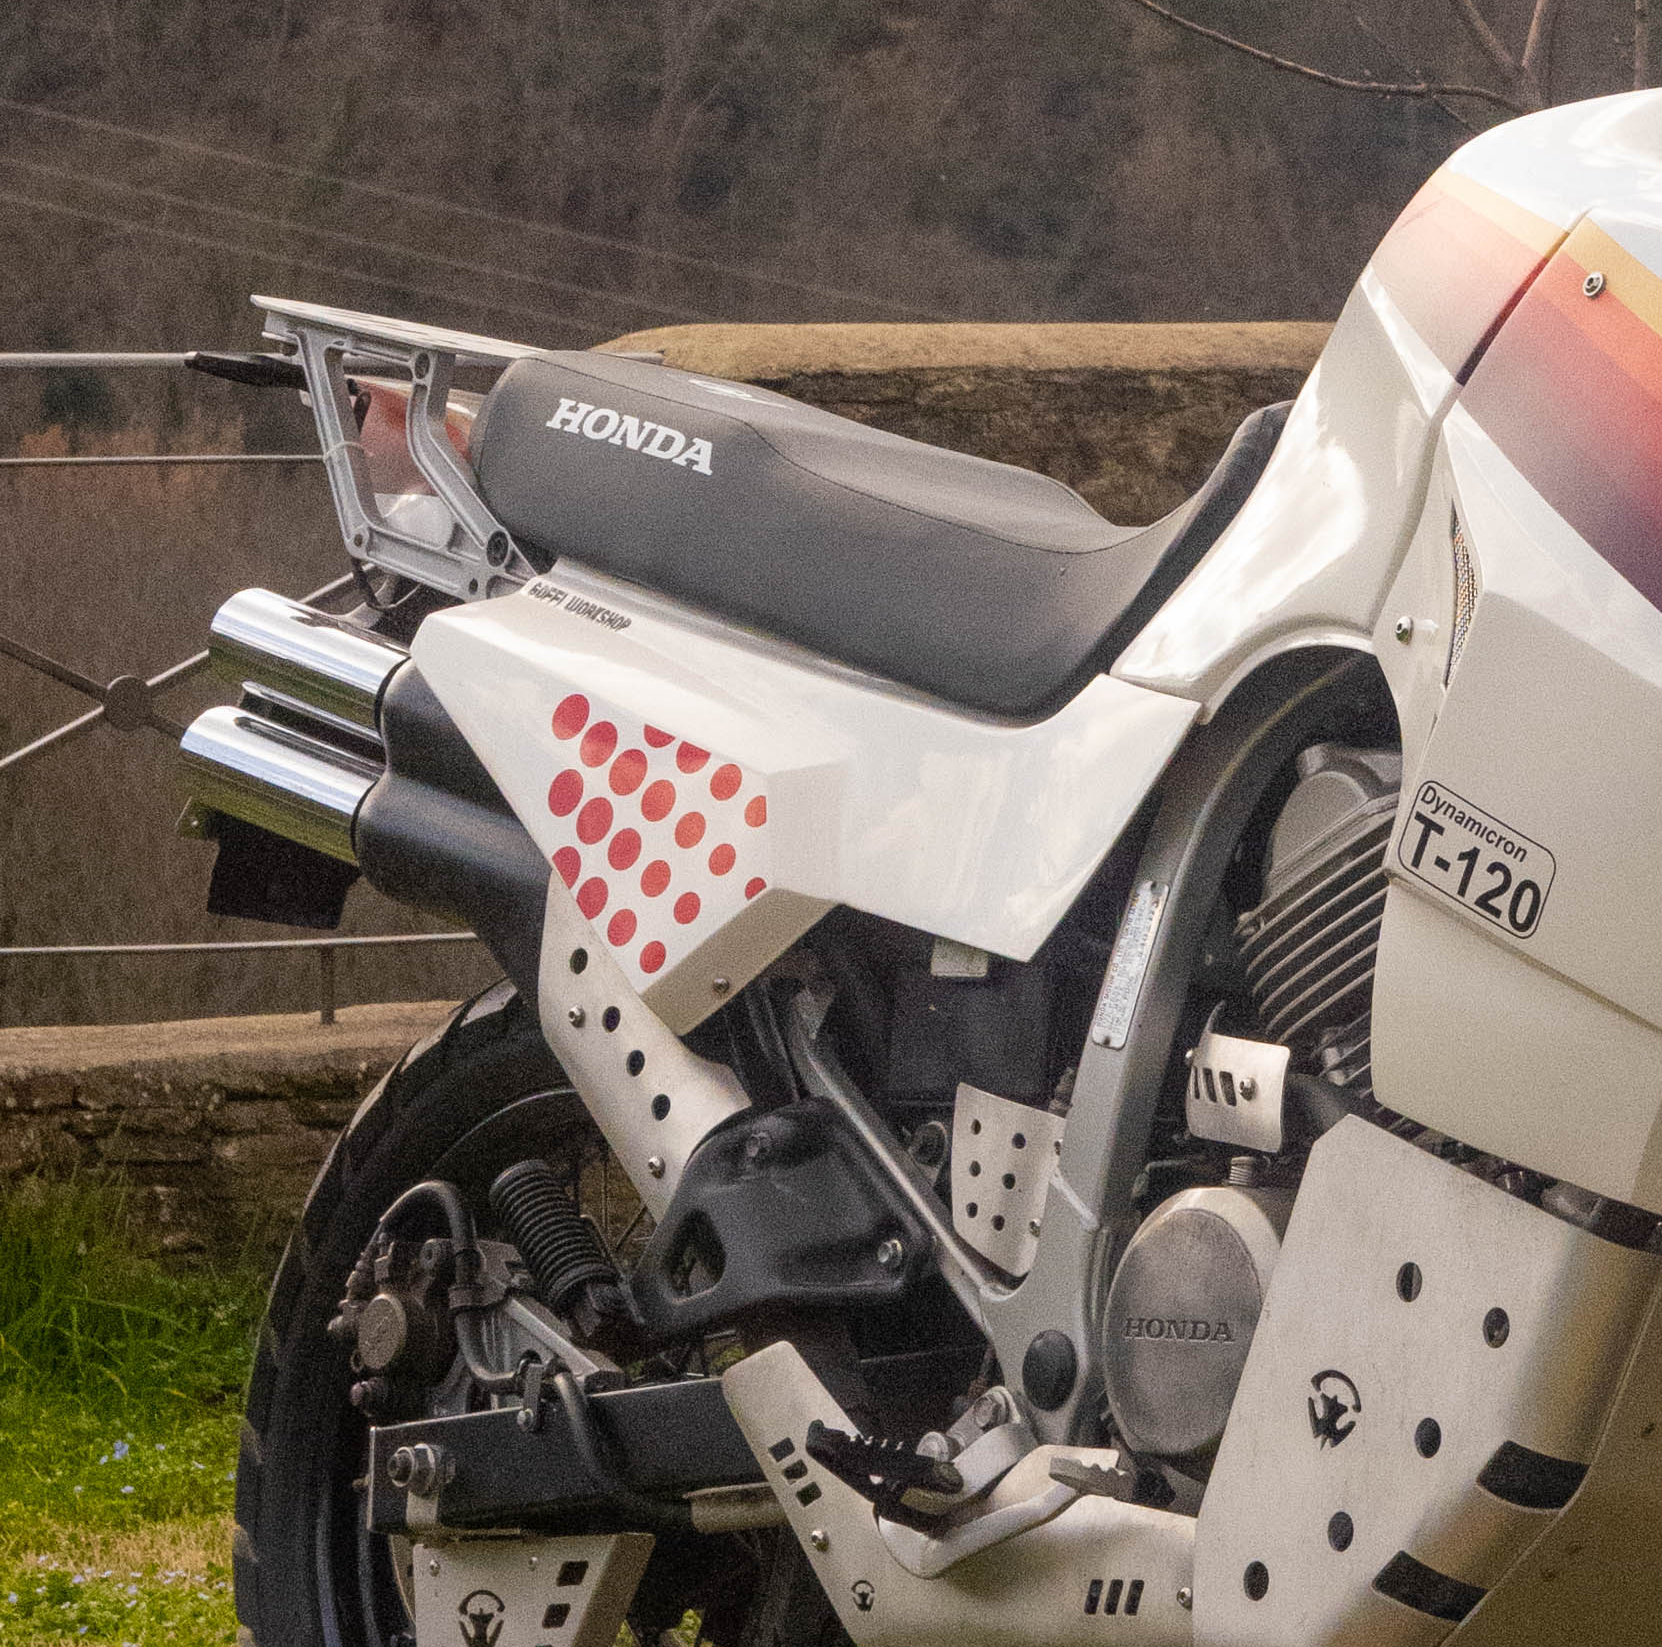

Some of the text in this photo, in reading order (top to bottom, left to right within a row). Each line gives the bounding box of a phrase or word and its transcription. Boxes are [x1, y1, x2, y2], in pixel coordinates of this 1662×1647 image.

[546, 398, 713, 476] HONDA
[564, 596, 632, 632] WORKSHOP
[1420, 785, 1528, 863] Dynamicron
[1411, 811, 1541, 933] T-120
[1122, 1318, 1236, 1344] HONDA
